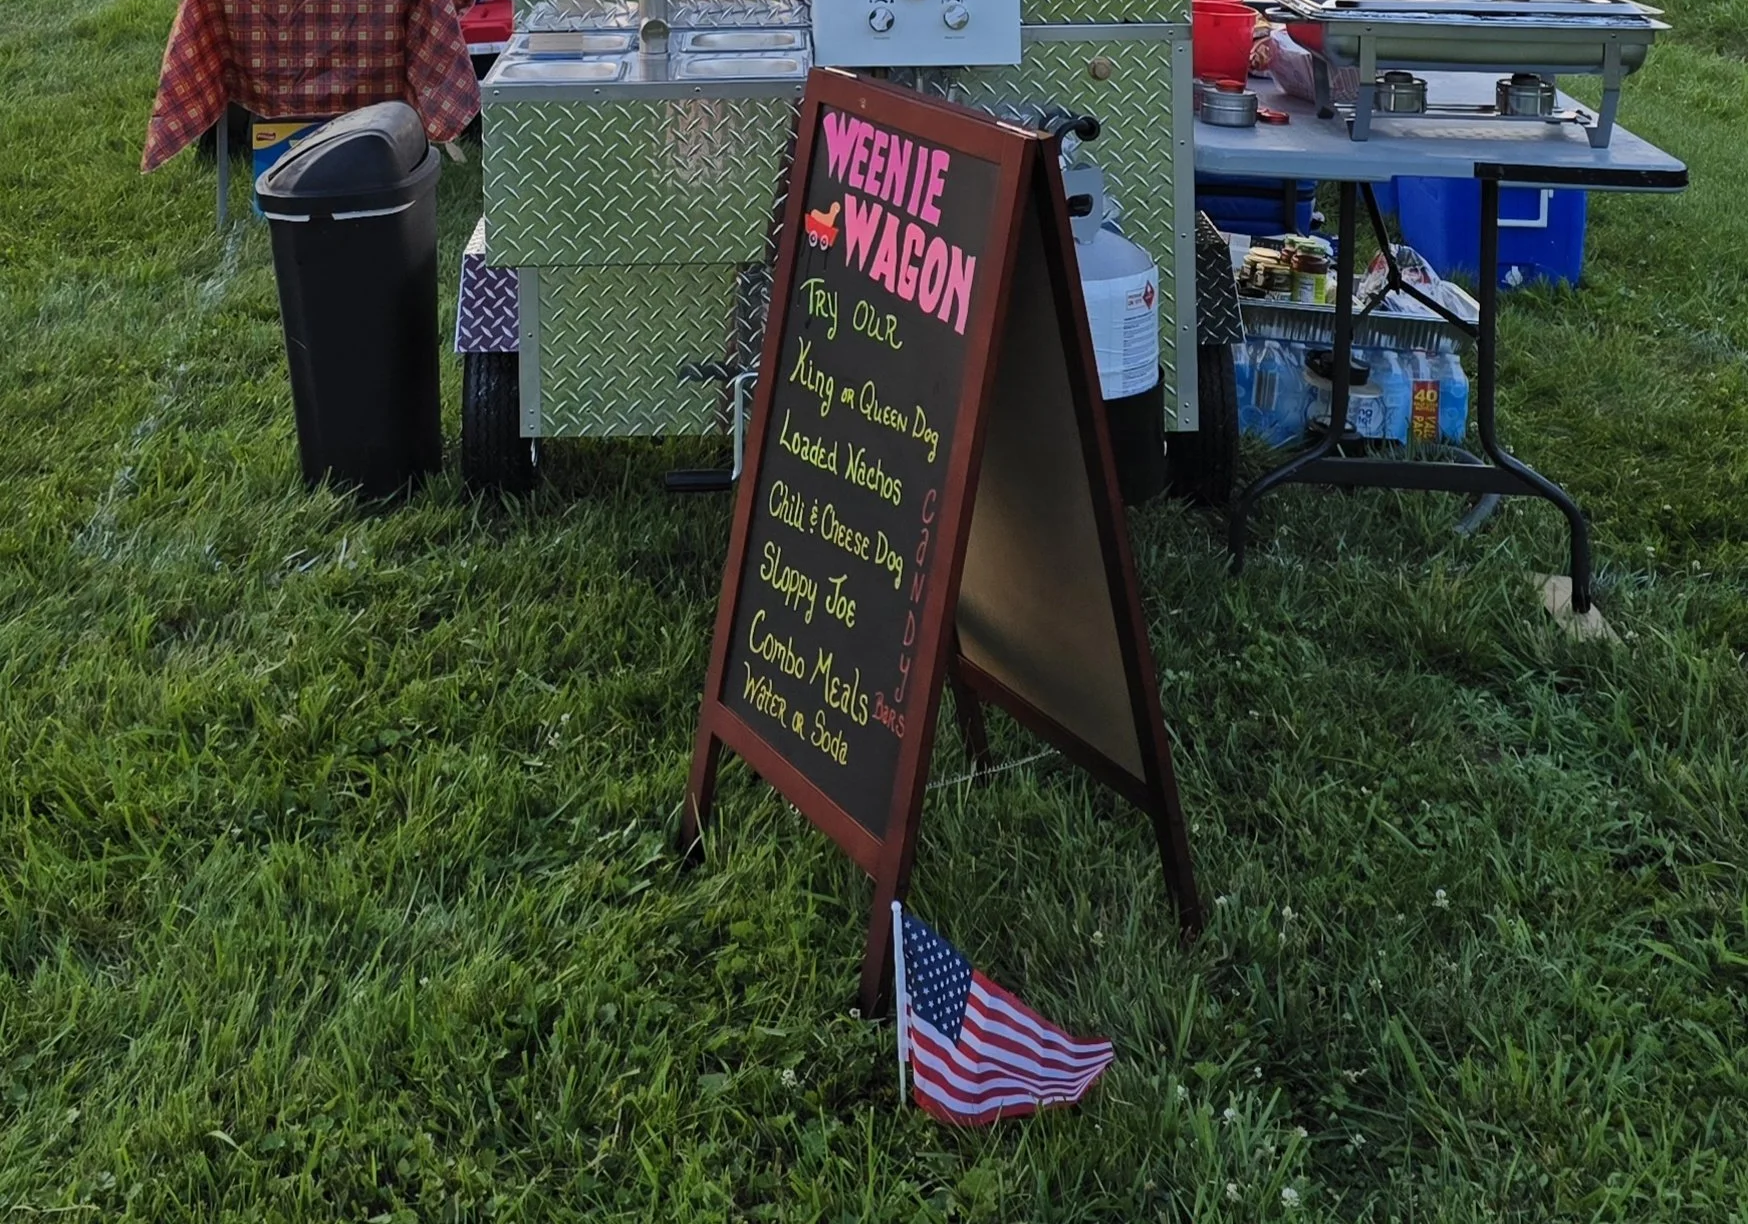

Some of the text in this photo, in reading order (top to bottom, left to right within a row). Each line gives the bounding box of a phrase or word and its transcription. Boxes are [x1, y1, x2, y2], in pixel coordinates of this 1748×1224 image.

[822, 112, 950, 226] WEENIE
[845, 195, 976, 335] WAGON
[853, 300, 902, 350] OUR
[790, 336, 835, 417] King
[912, 406, 939, 463] Dog
[1414, 389, 1438, 402] 40
[779, 409, 902, 505] Loaded Nachos
[769, 481, 805, 533] Chili
[874, 531, 904, 590] Dog
[749, 609, 870, 726] Combo Meals
[811, 711, 849, 765] Soda
